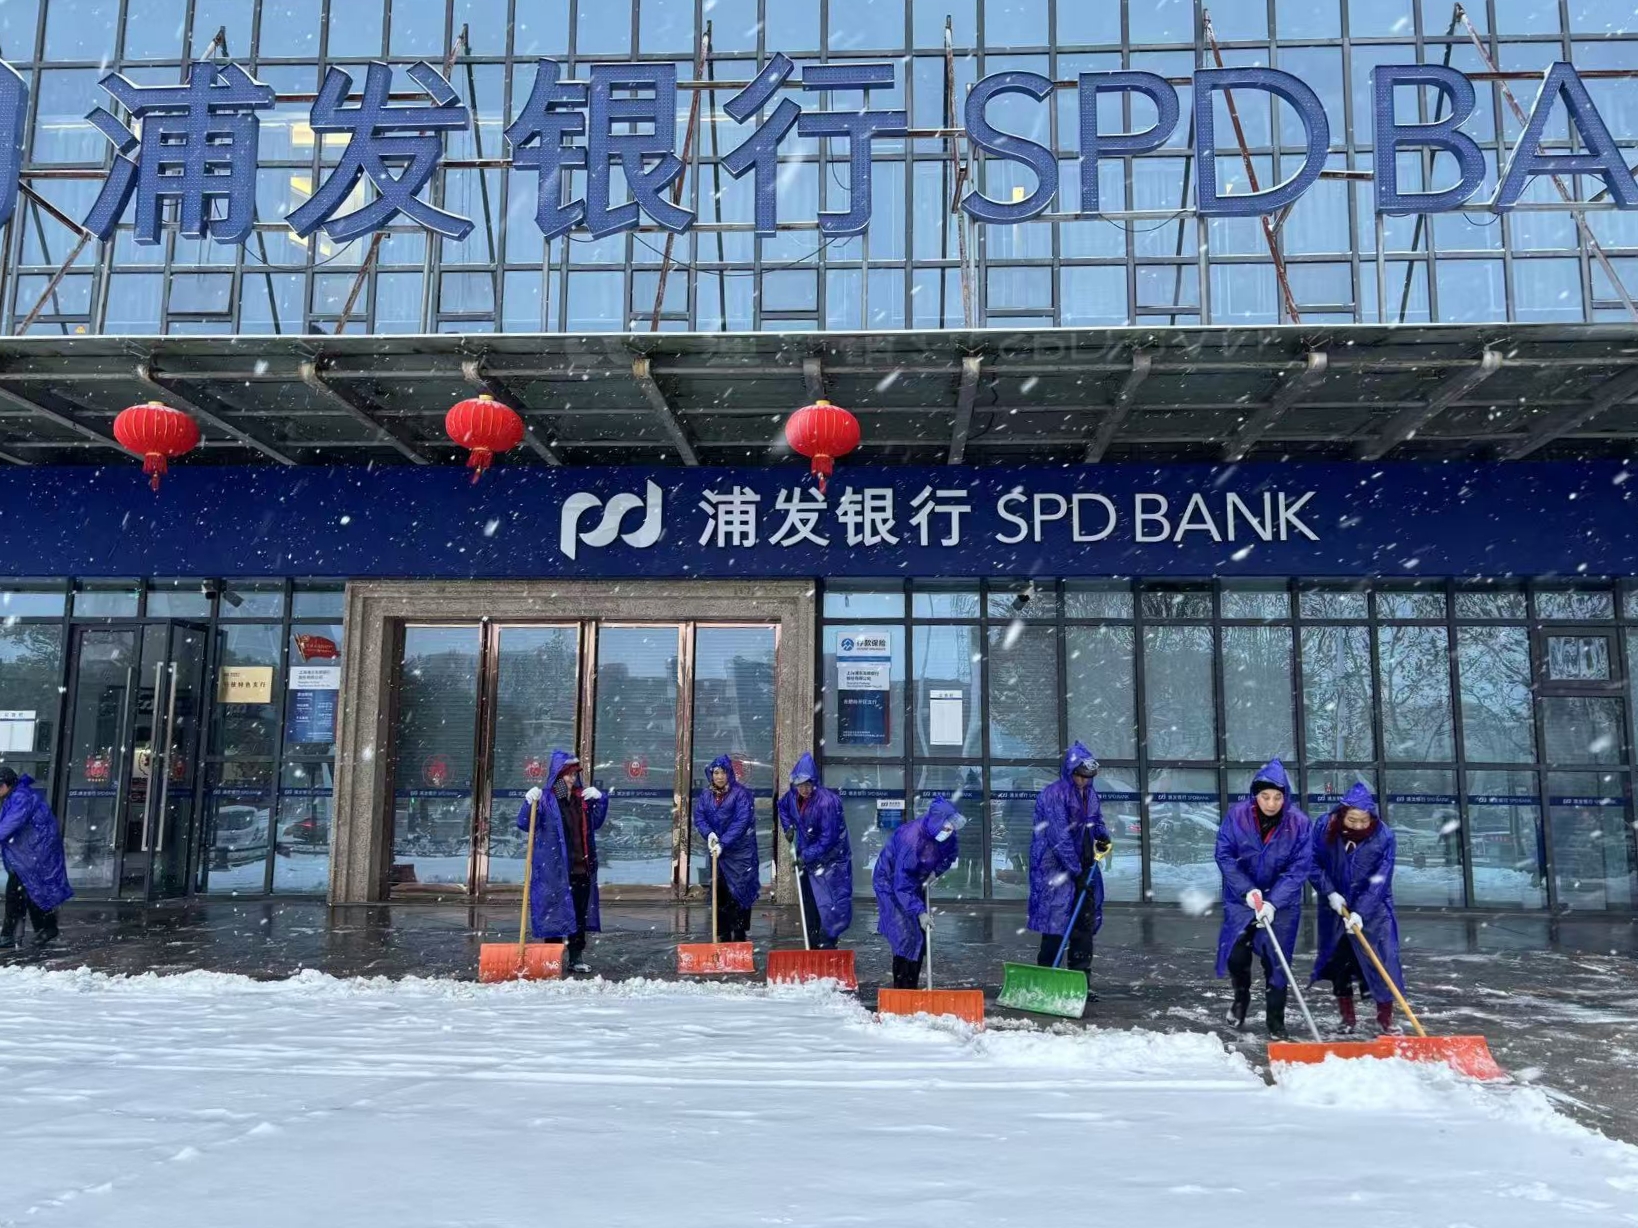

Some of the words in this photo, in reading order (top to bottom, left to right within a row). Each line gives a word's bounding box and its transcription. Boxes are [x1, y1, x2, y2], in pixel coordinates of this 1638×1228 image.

[83, 52, 908, 244] 浦发银行
[961, 65, 1330, 225] SPD
[698, 485, 971, 548] 浦发银行
[995, 492, 1117, 544] SPD
[1135, 491, 1321, 543] BANK
